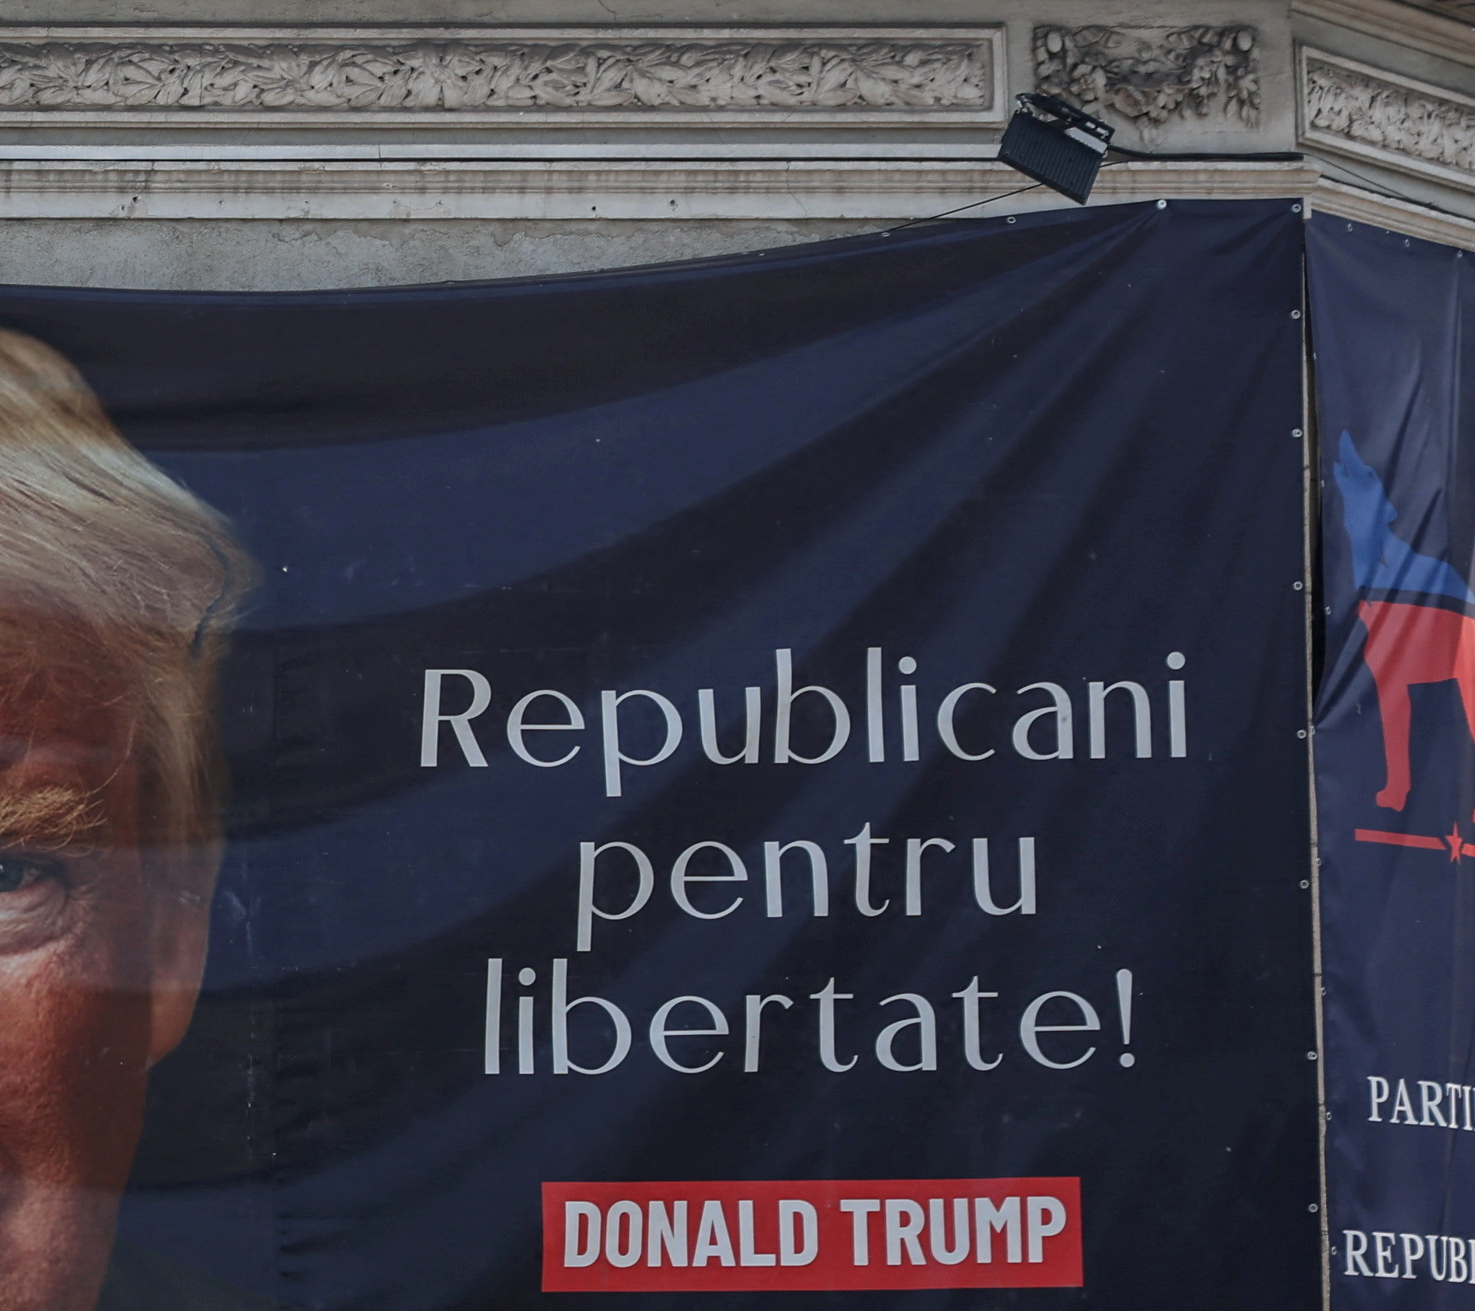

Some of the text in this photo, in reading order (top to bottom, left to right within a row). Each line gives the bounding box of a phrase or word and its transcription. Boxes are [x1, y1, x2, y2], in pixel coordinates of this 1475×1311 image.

[419, 648, 1188, 797] Republicani
[576, 821, 1038, 951] pentru
[484, 958, 1137, 1076] libertate!
[1366, 1075, 1475, 1132] PARTI
[564, 1196, 1068, 1269] DONALD TRUMP
